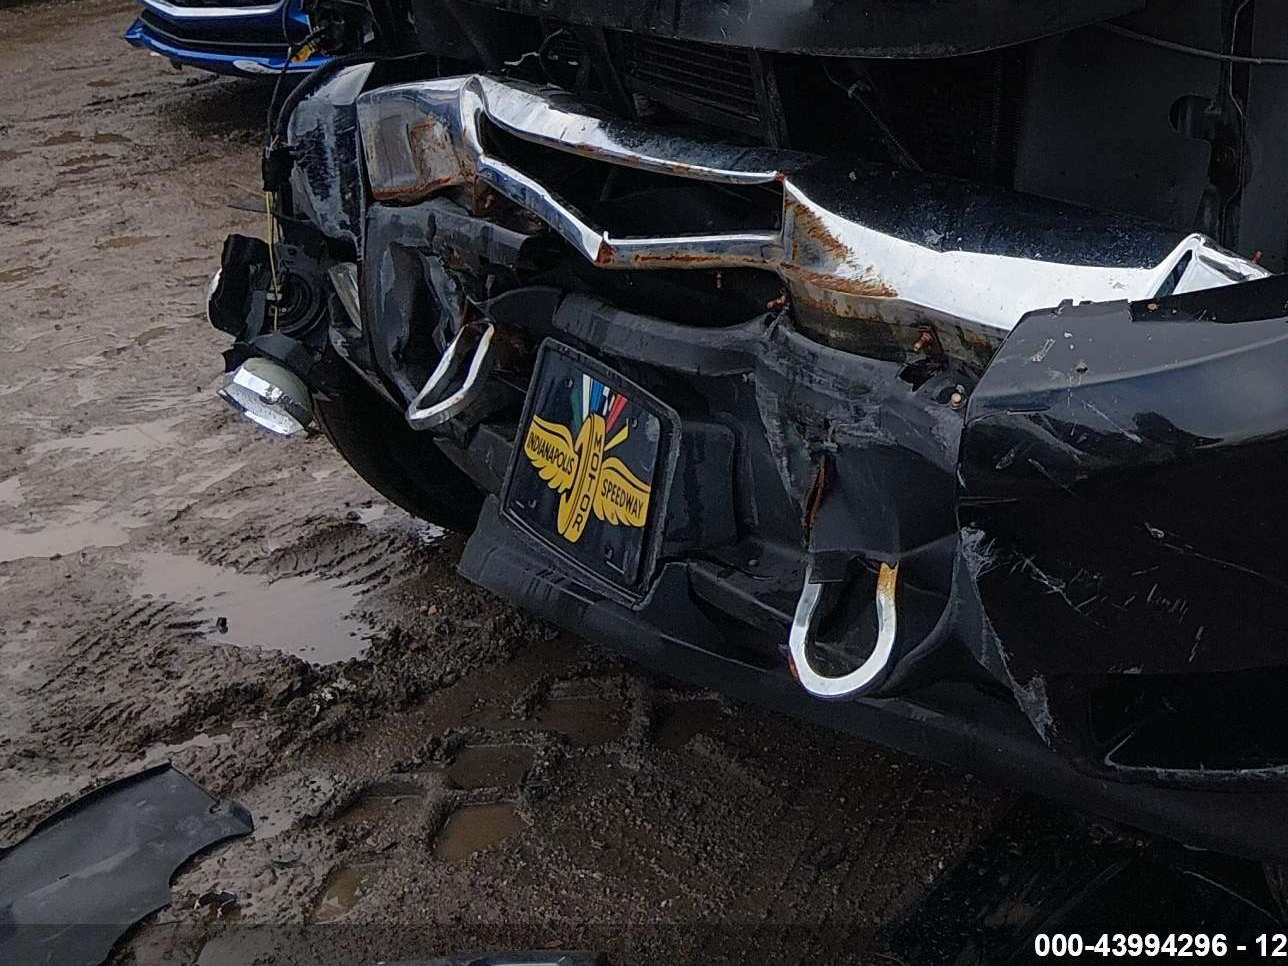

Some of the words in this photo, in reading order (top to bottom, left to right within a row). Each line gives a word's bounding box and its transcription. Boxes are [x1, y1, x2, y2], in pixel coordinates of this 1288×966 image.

[527, 430, 575, 476] INDIANAPOLIS
[571, 434, 603, 532] MOTOR
[600, 480, 645, 519] SPEEDWAY
